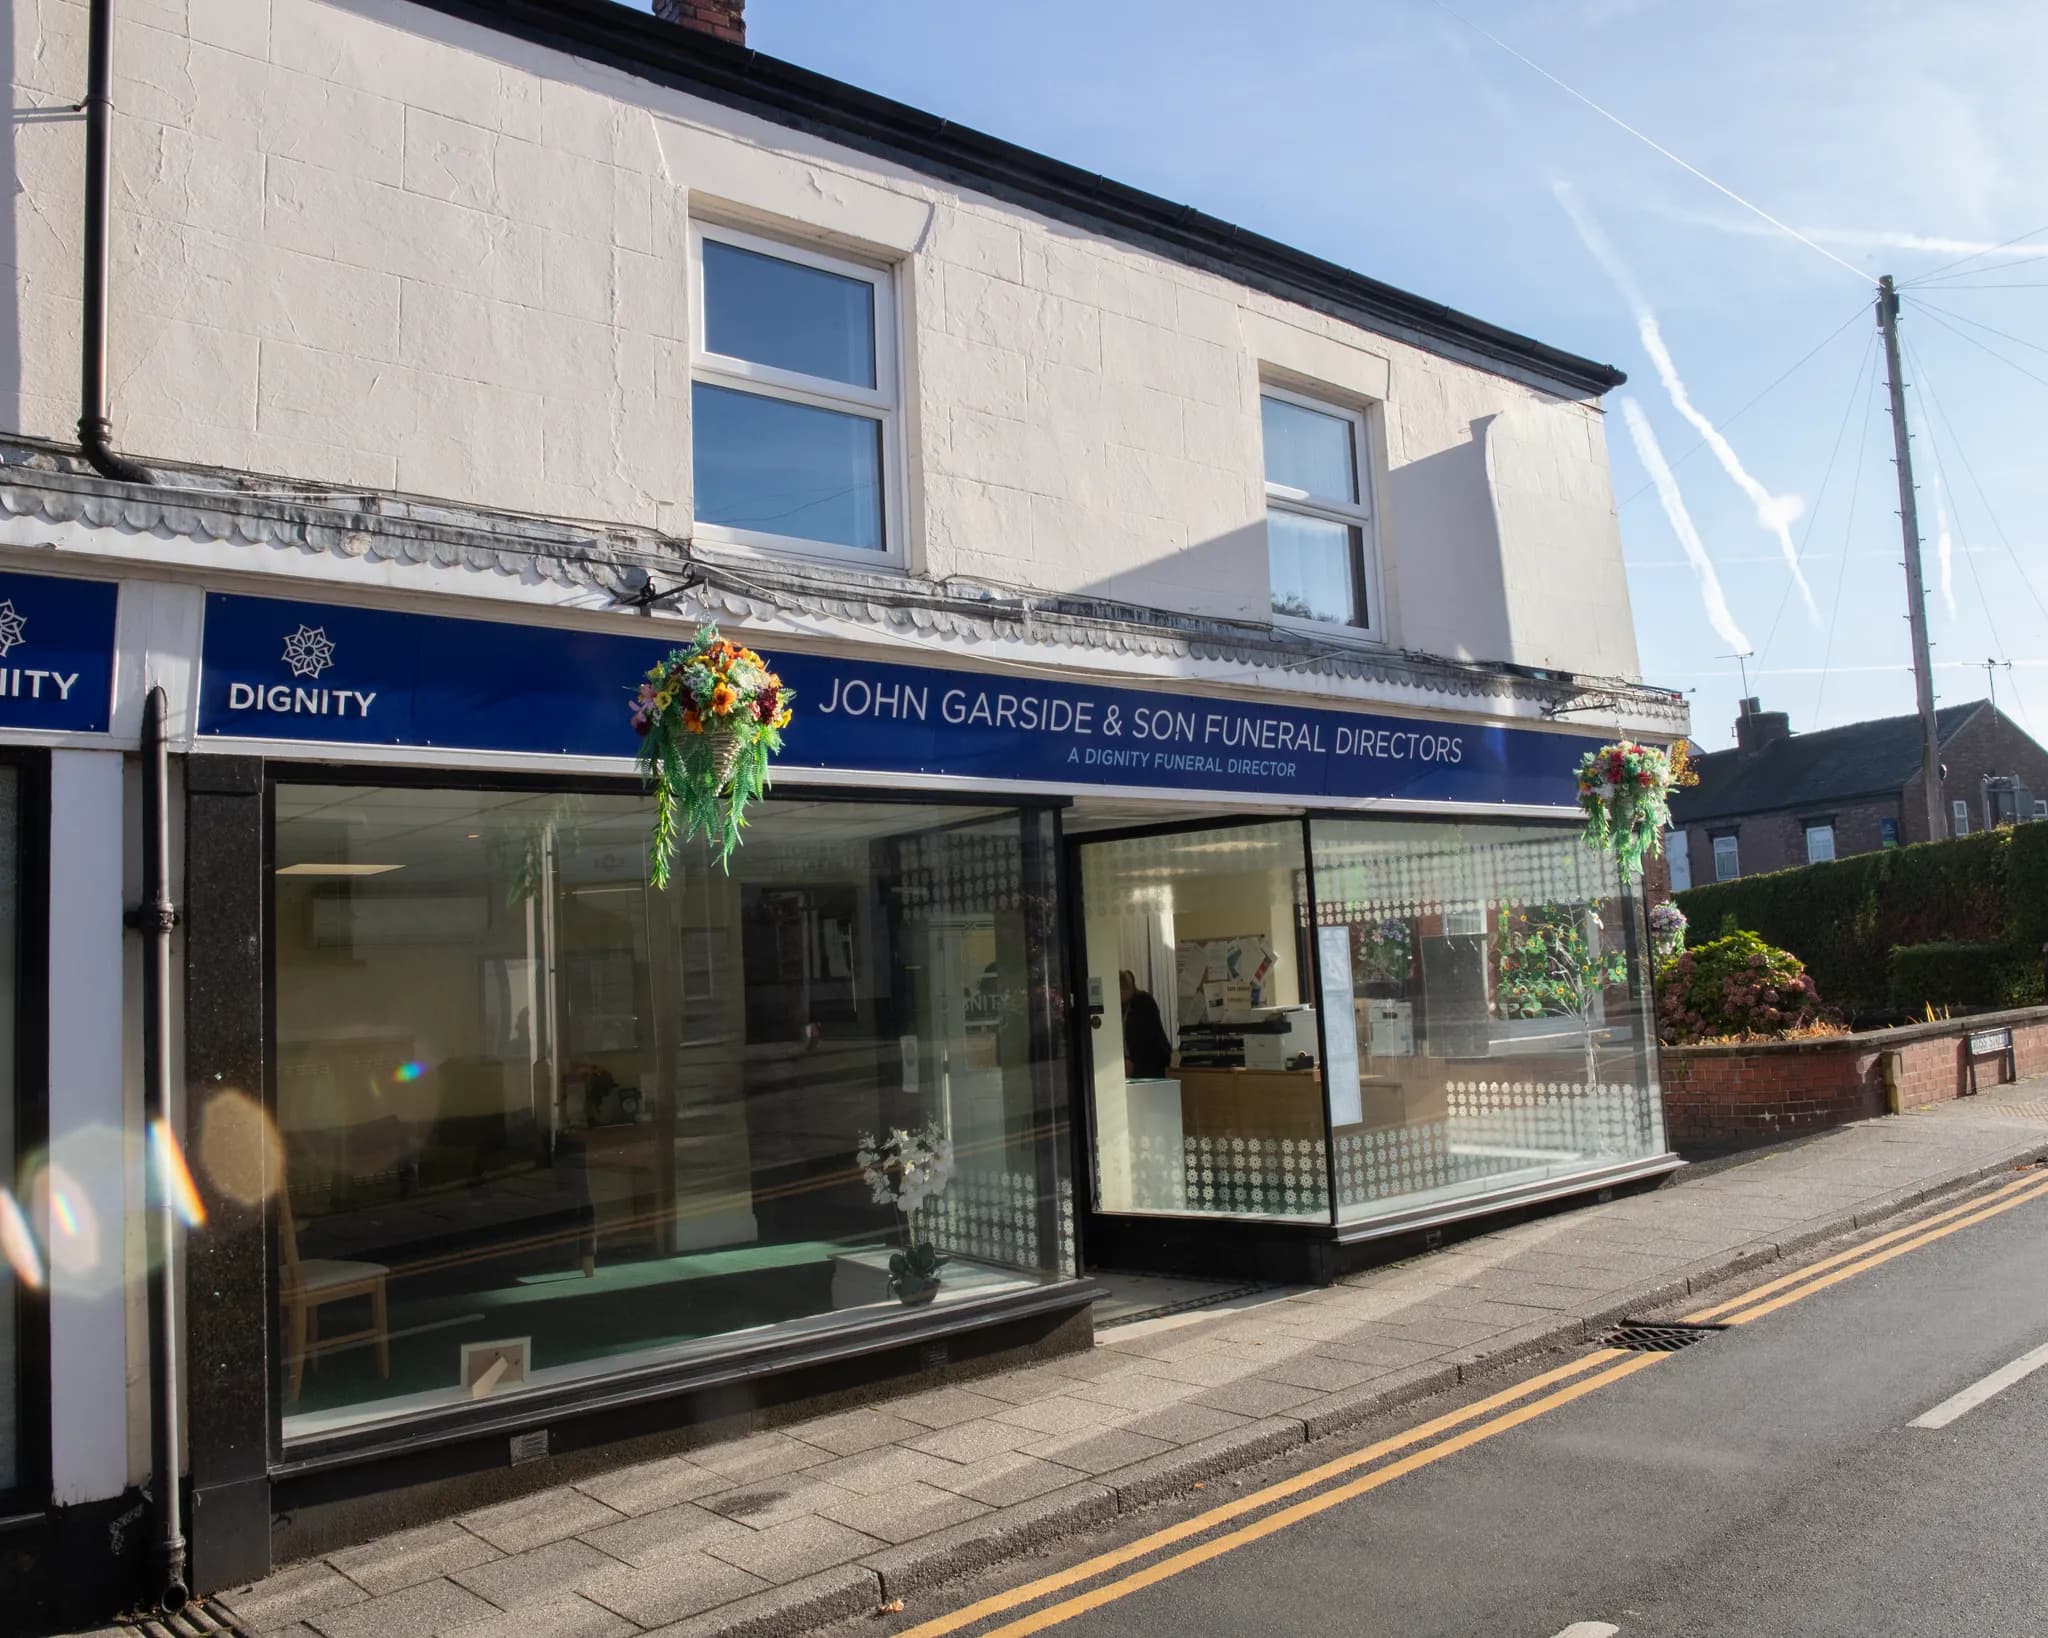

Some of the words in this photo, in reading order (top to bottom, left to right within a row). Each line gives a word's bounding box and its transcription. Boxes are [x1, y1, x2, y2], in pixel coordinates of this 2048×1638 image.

[229, 682, 377, 717] DIGNITY
[818, 678, 928, 721] JOHN
[942, 689, 1094, 734] GARSIDE
[1103, 704, 1123, 737] &
[1132, 707, 1197, 742] SON
[1204, 714, 1327, 753] FUNERAL
[1335, 727, 1463, 763] DIRECTORS
[1067, 747, 1079, 763] A
[1085, 748, 1150, 768] DIGNITY
[1154, 753, 1224, 773] FUNERAL
[1227, 758, 1296, 777] DIRECTOR
